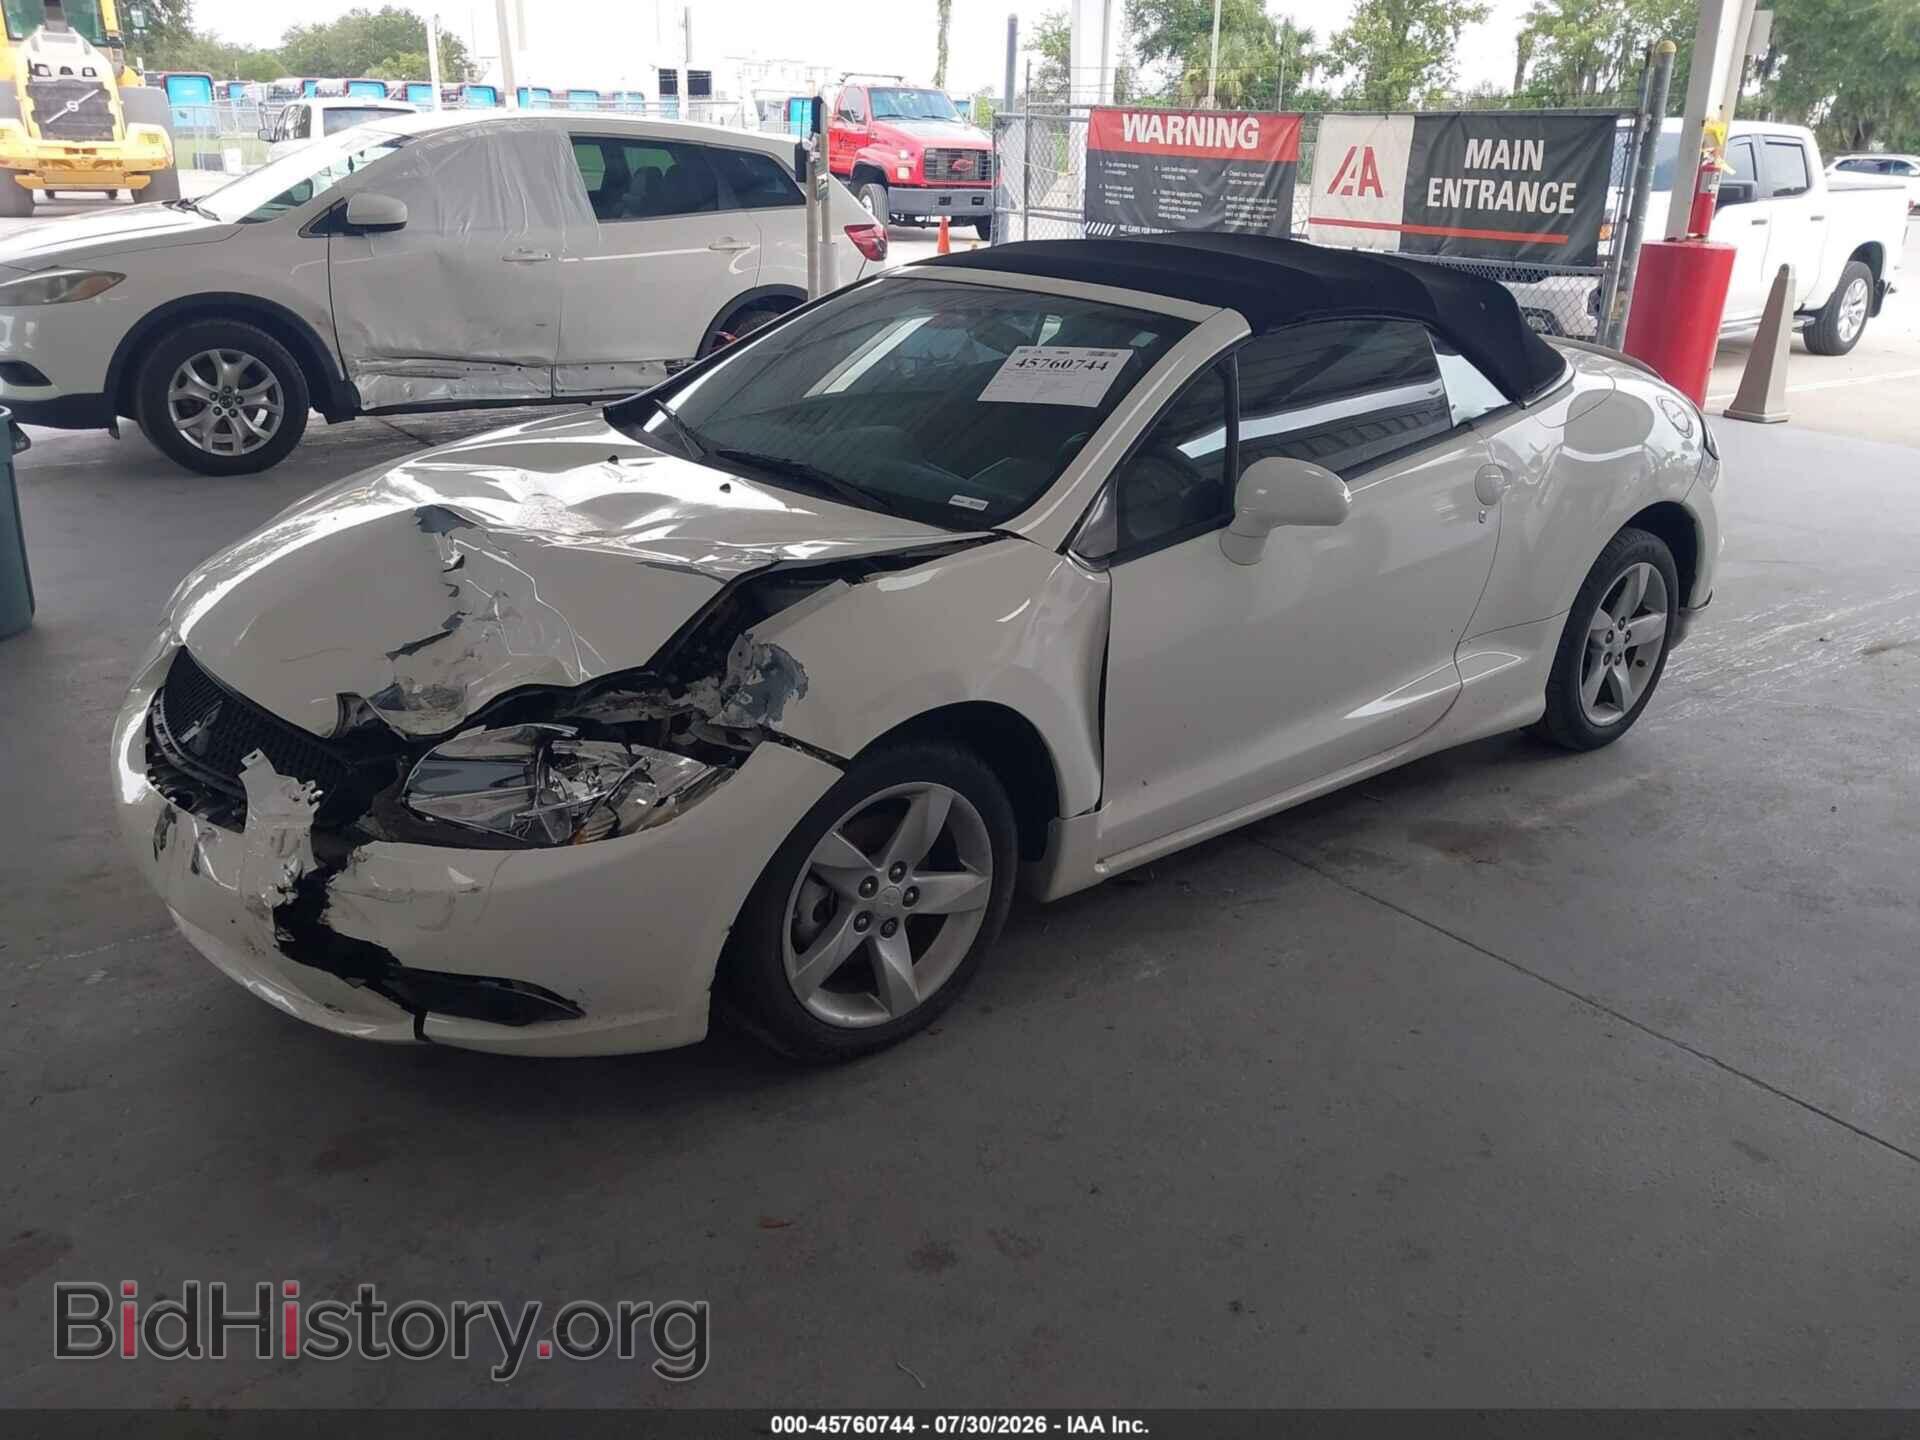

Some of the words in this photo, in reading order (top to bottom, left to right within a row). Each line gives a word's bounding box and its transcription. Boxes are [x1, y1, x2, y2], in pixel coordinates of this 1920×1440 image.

[1122, 113, 1260, 149] WARNING
[1463, 138, 1545, 172] MAIN
[1426, 177, 1577, 214] ENTRANCE
[1015, 357, 1109, 371] 45760744
